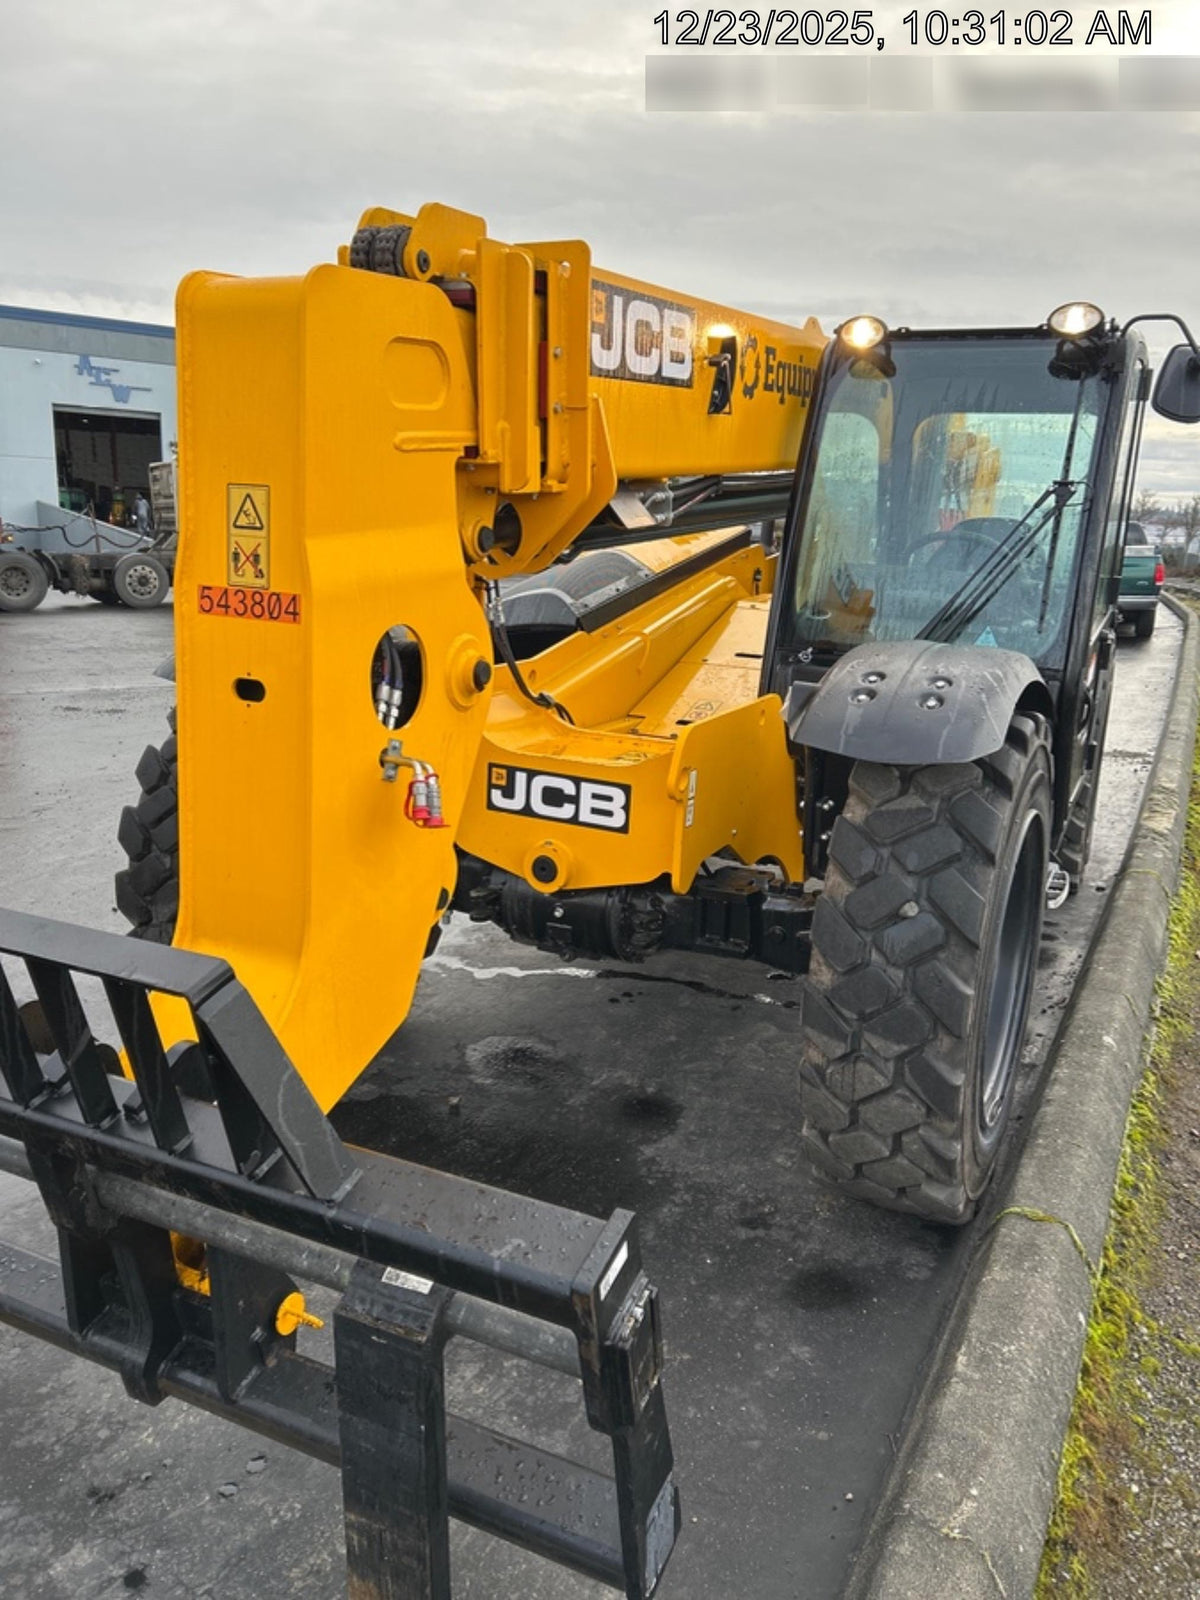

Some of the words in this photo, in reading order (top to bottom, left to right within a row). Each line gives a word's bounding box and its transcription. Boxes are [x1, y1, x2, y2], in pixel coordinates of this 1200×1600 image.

[591, 294, 693, 380] JCB
[763, 346, 816, 407] Equip
[200, 586, 300, 622] 543804
[490, 771, 627, 828] JCB
